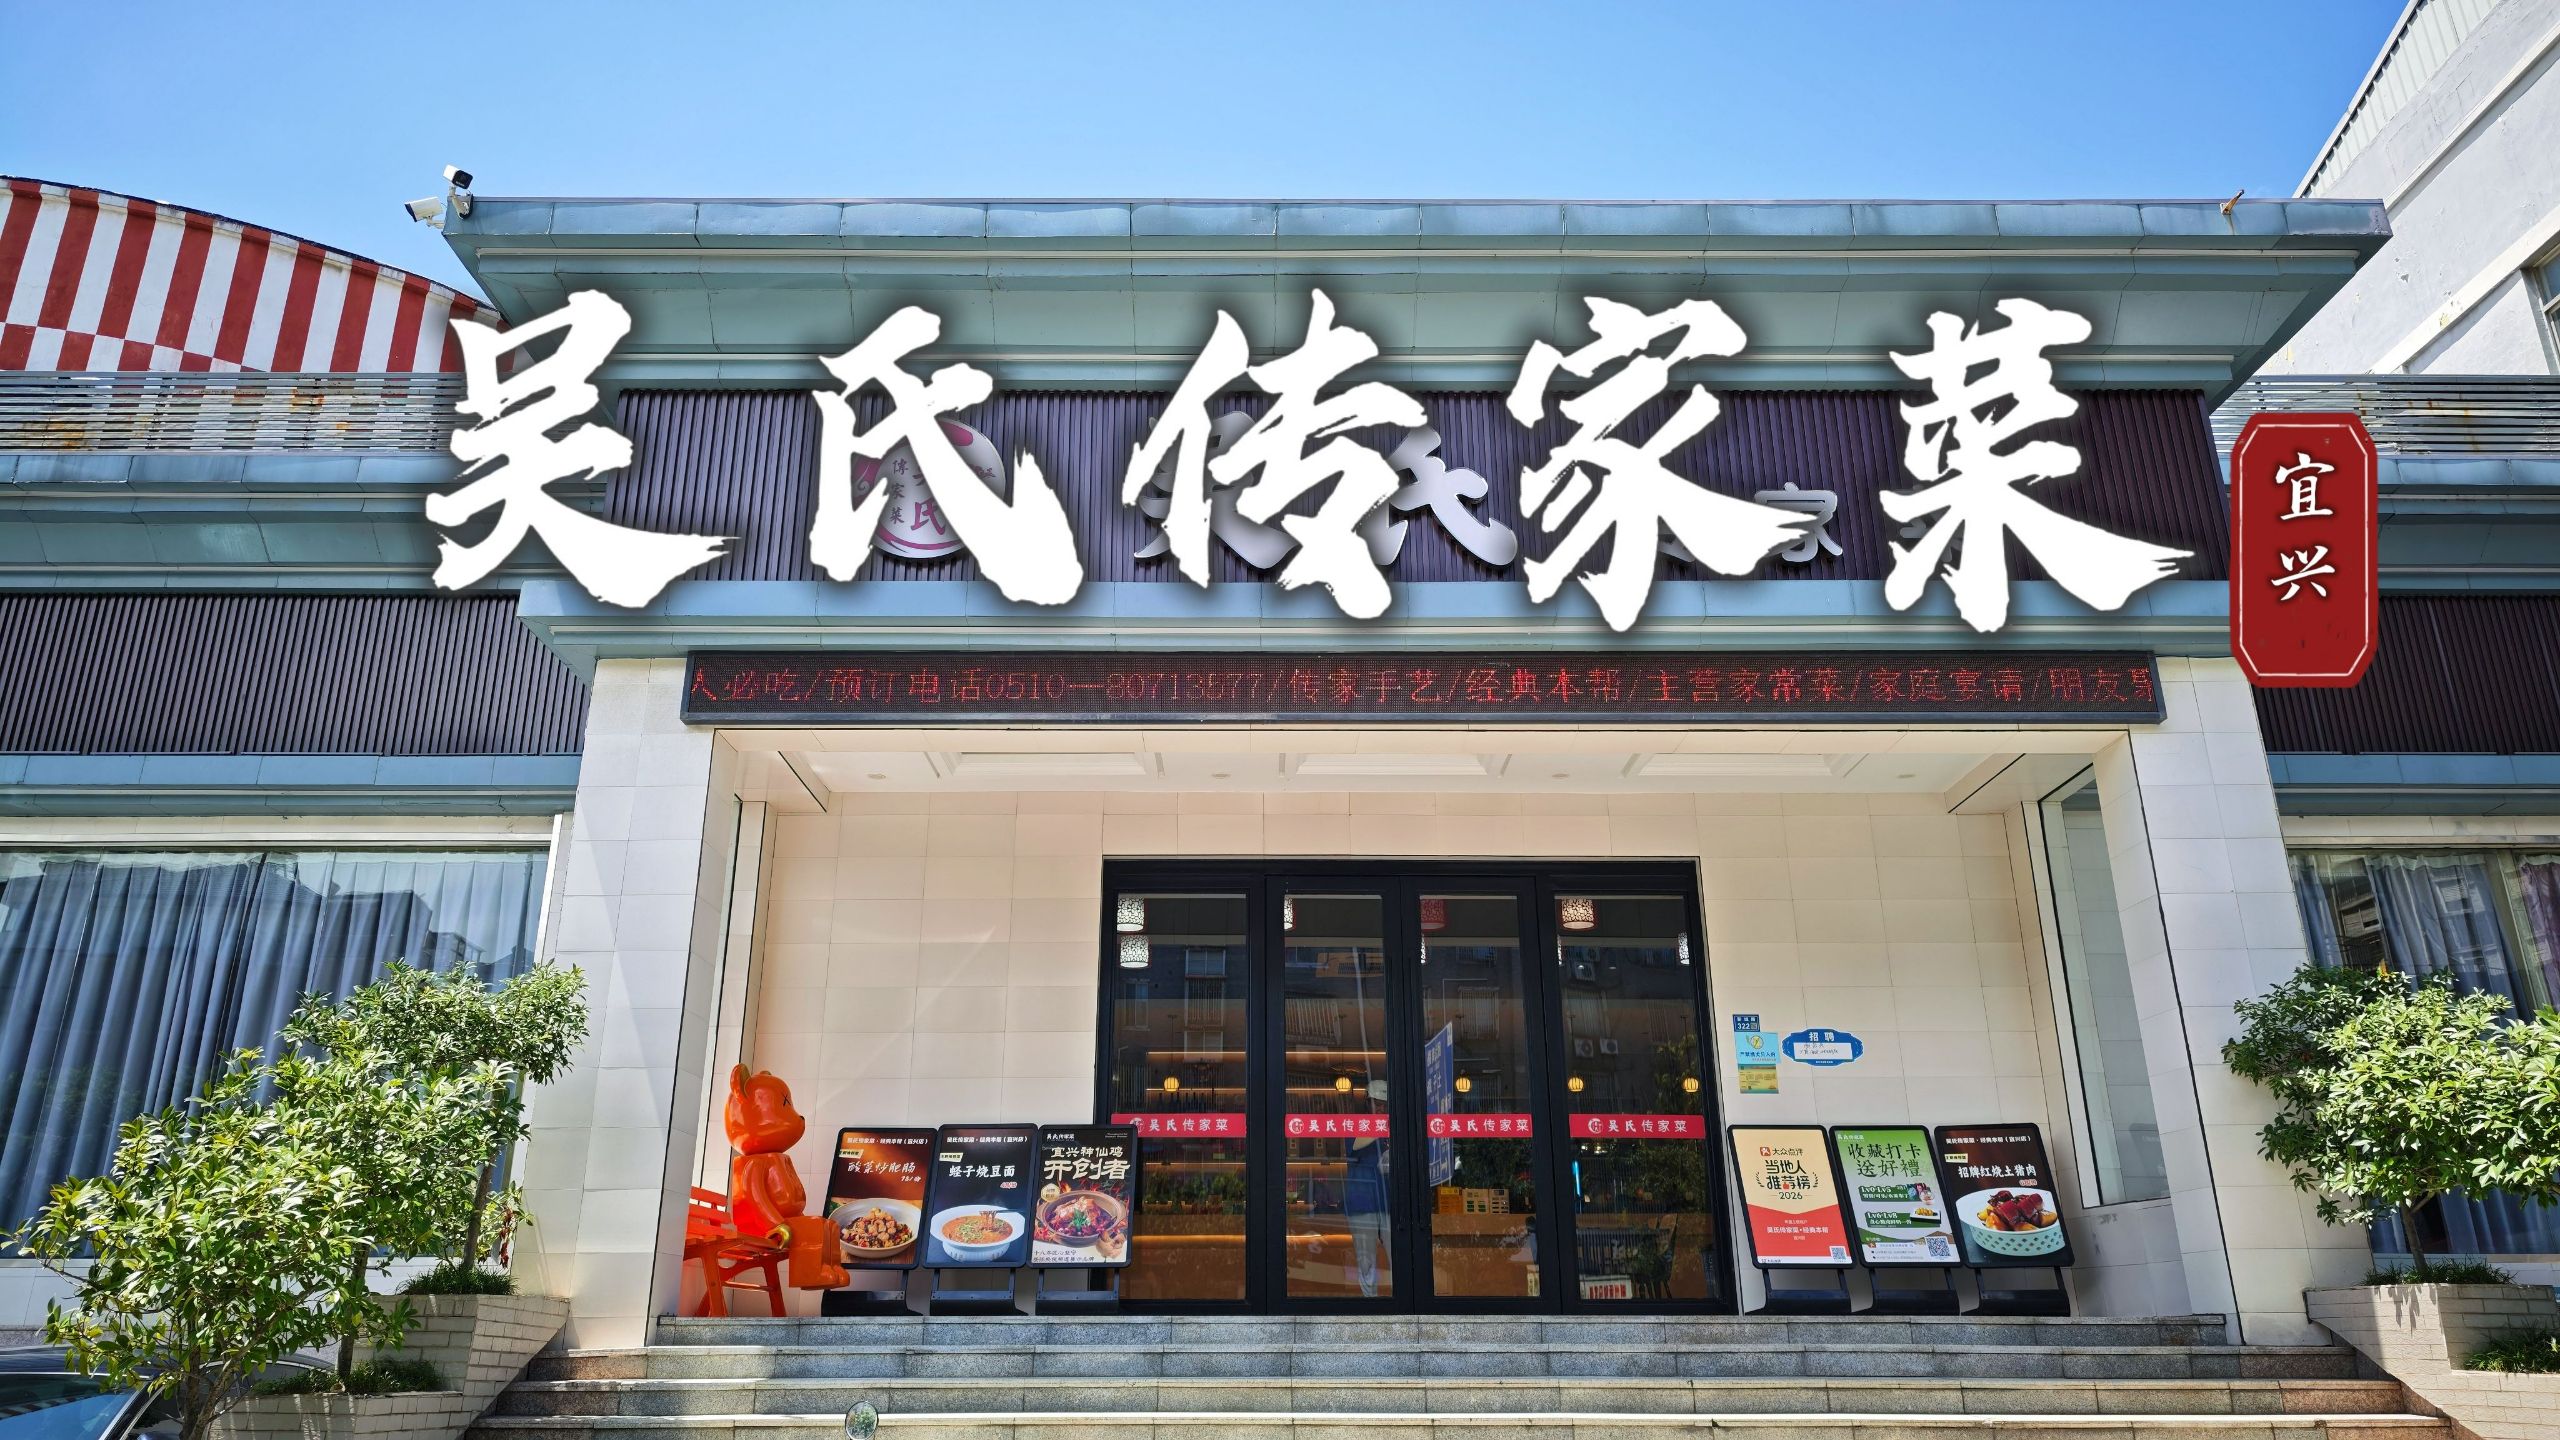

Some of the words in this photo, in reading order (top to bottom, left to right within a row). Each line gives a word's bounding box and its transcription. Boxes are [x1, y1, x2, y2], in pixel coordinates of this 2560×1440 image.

[1737, 1022, 1750, 1030] 322
[1808, 1031, 1835, 1042] 招聘
[1148, 1118, 1228, 1132] 吴氏传家菜
[1308, 1118, 1388, 1132] 吴氏传家菜
[1450, 1118, 1529, 1132] 吴氏传家菜
[1608, 1119, 1687, 1133] 吴氏传家菜
[1050, 1146, 1123, 1158] 宜兴神仙鸡
[1772, 1147, 1804, 1156] 大众点评
[1847, 1142, 1921, 1160] 收藏打卡
[847, 1160, 916, 1175] 酸菜炒肥肠
[948, 1164, 1016, 1178] 蛏子烧豆面
[1043, 1157, 1131, 1182] 开创者
[1764, 1159, 1807, 1175] 当地人
[1856, 1159, 1923, 1178] 送好禮
[1957, 1163, 2037, 1179] 招牌红烧土猪肉
[1766, 1175, 1811, 1190] 推荐榜
[1778, 1191, 1803, 1200] 2026
